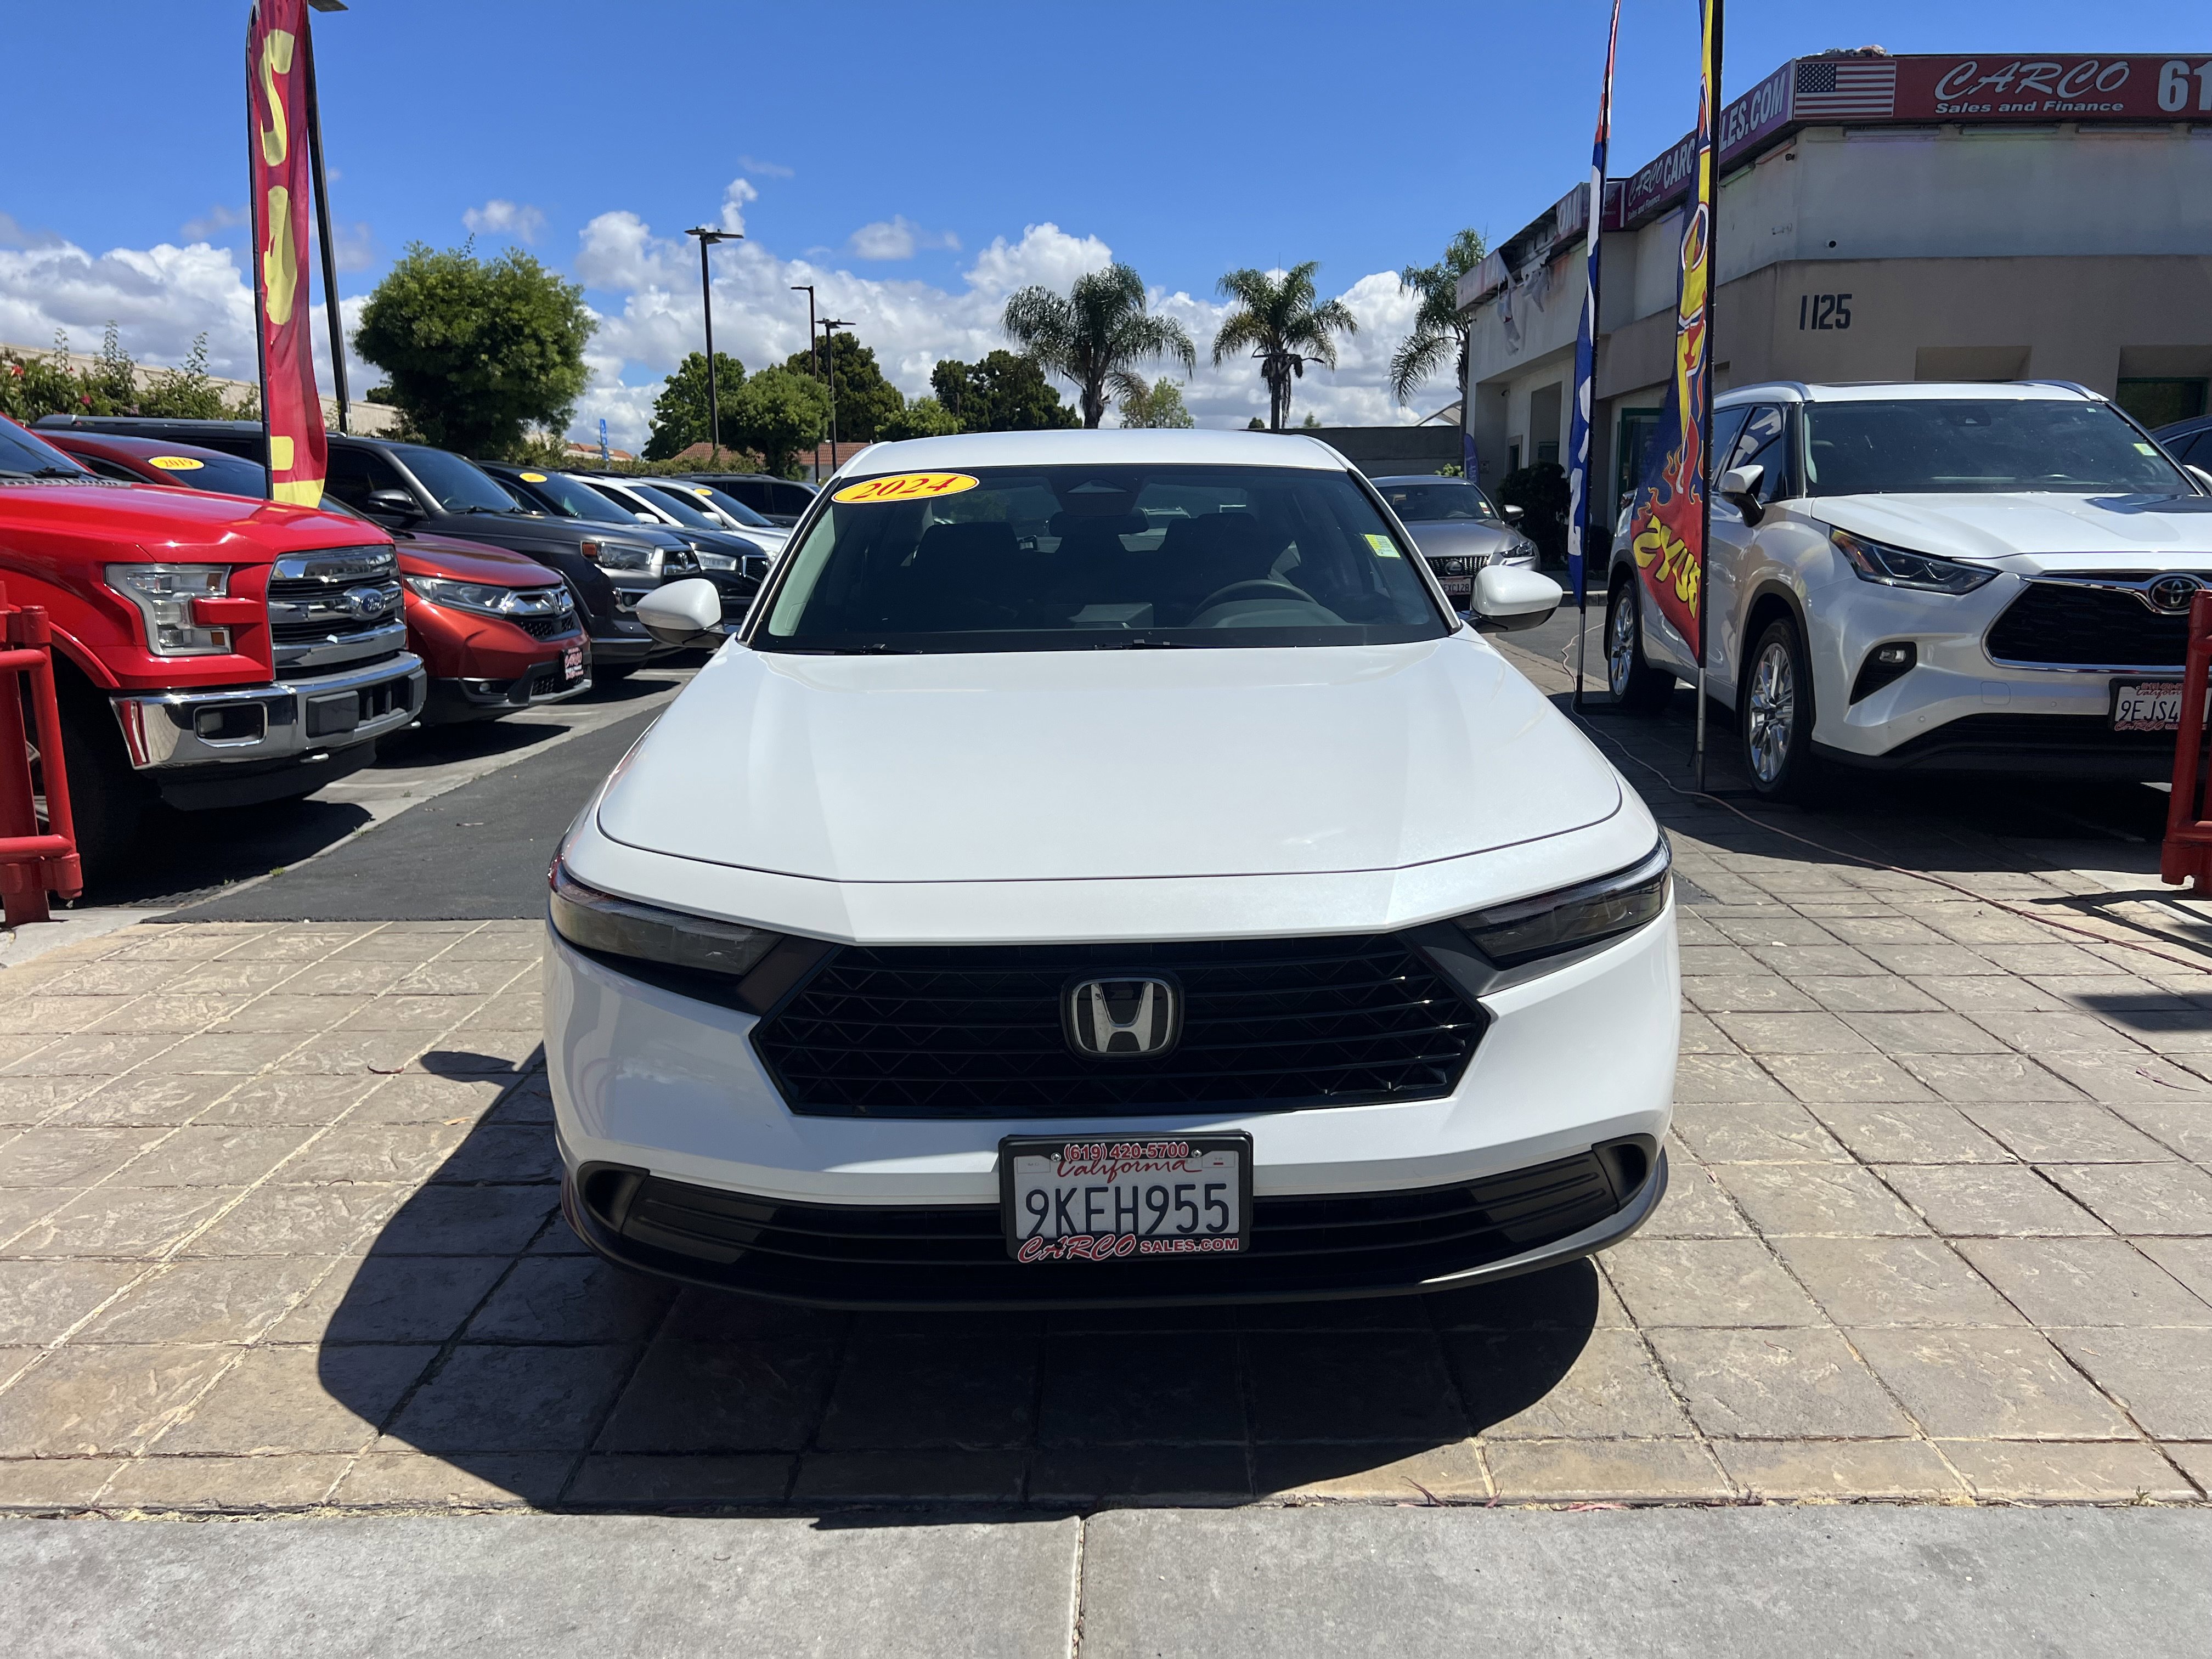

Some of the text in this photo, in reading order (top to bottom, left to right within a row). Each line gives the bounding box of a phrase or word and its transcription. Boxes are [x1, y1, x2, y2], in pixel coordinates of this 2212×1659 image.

[1934, 60, 2130, 100] CARCO
[1935, 100, 2124, 114] Sales and Finance
[1628, 159, 1663, 207] CARCO
[1798, 293, 1853, 331] 1125
[850, 476, 960, 500] 2024
[2119, 700, 2179, 722] 9EJS4
[1064, 1142, 1189, 1161] (619) 420-5700
[1057, 1159, 1202, 1184] California
[1025, 1183, 1229, 1238] 9KEH955
[1017, 1233, 1239, 1263] CARCO SALES.COM
